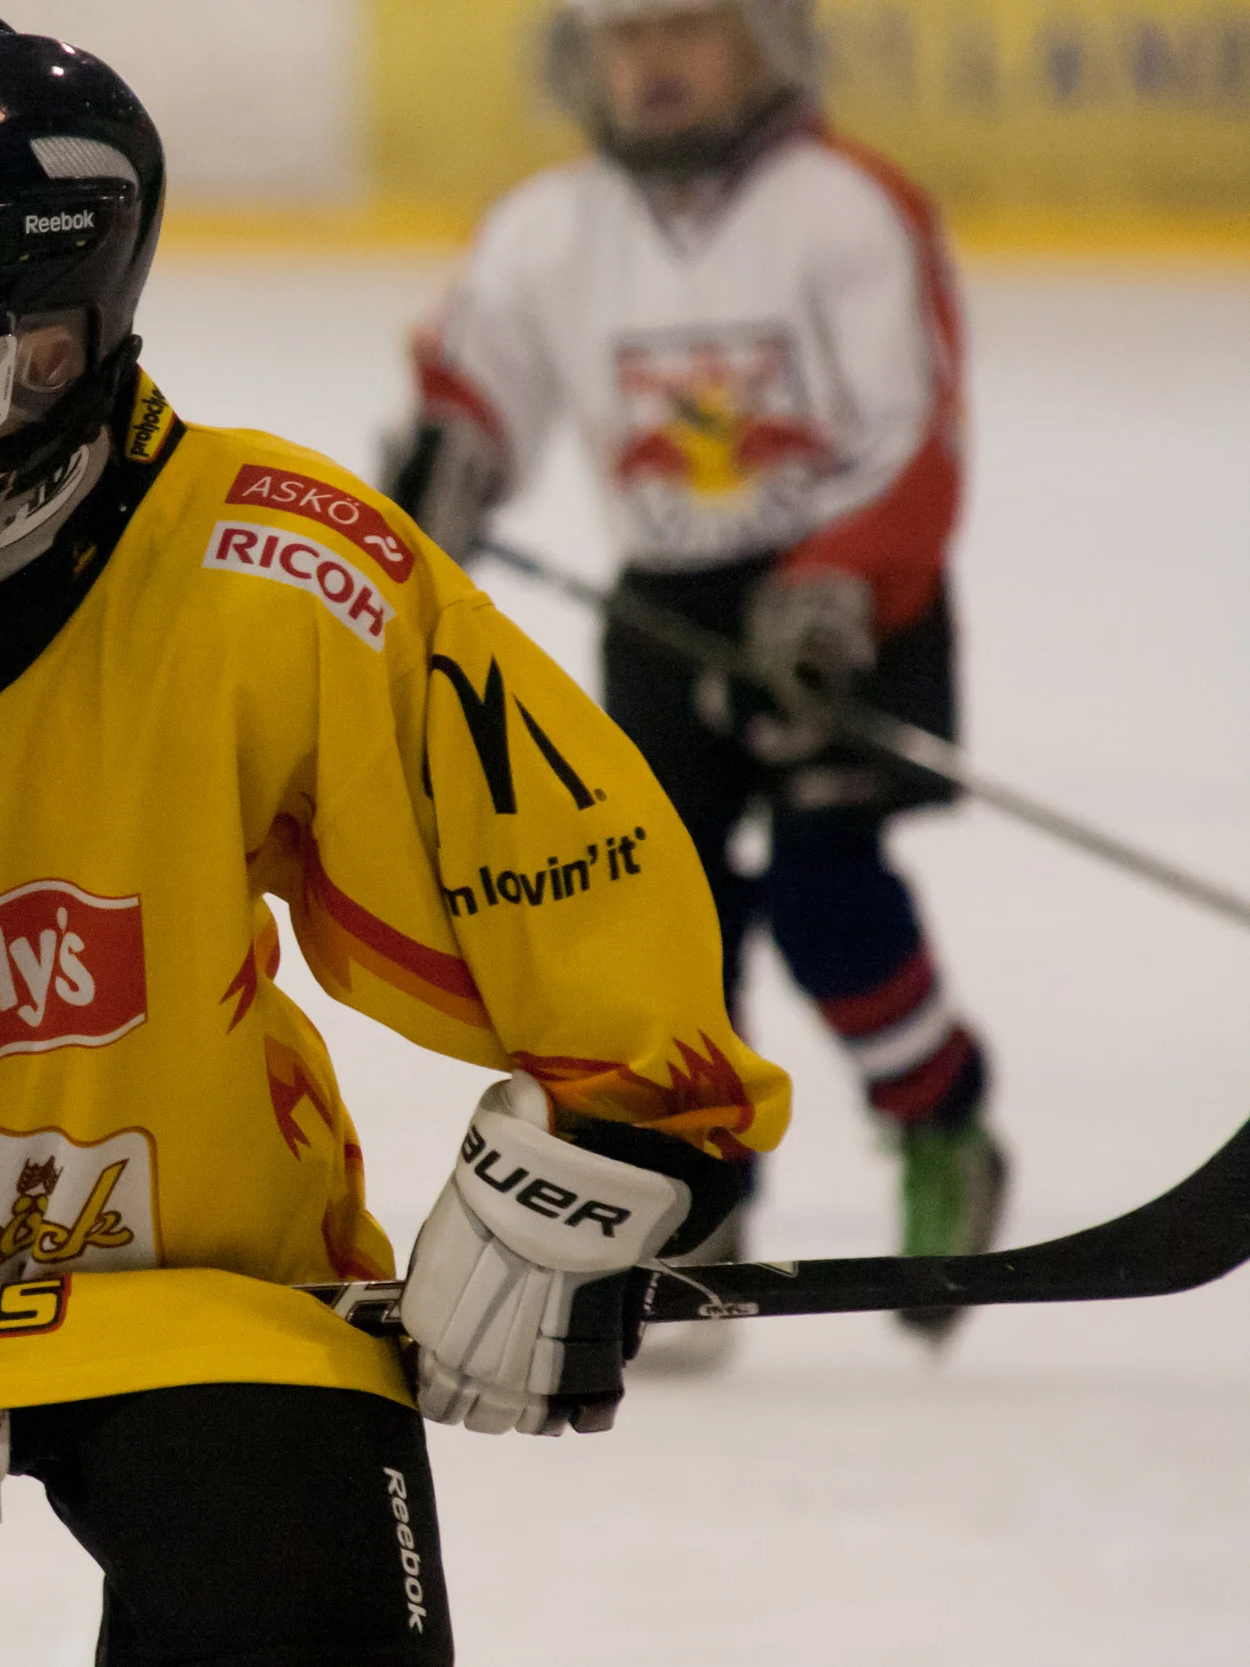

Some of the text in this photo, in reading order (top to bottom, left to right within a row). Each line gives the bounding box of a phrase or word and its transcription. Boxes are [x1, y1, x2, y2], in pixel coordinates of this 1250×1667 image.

[24, 209, 96, 235] Reebok
[130, 388, 168, 458] prohocke
[242, 475, 360, 526] ASKÖ
[215, 527, 386, 637] RICOH
[479, 844, 599, 906] lovin'
[382, 1465, 429, 1636] Reebok
